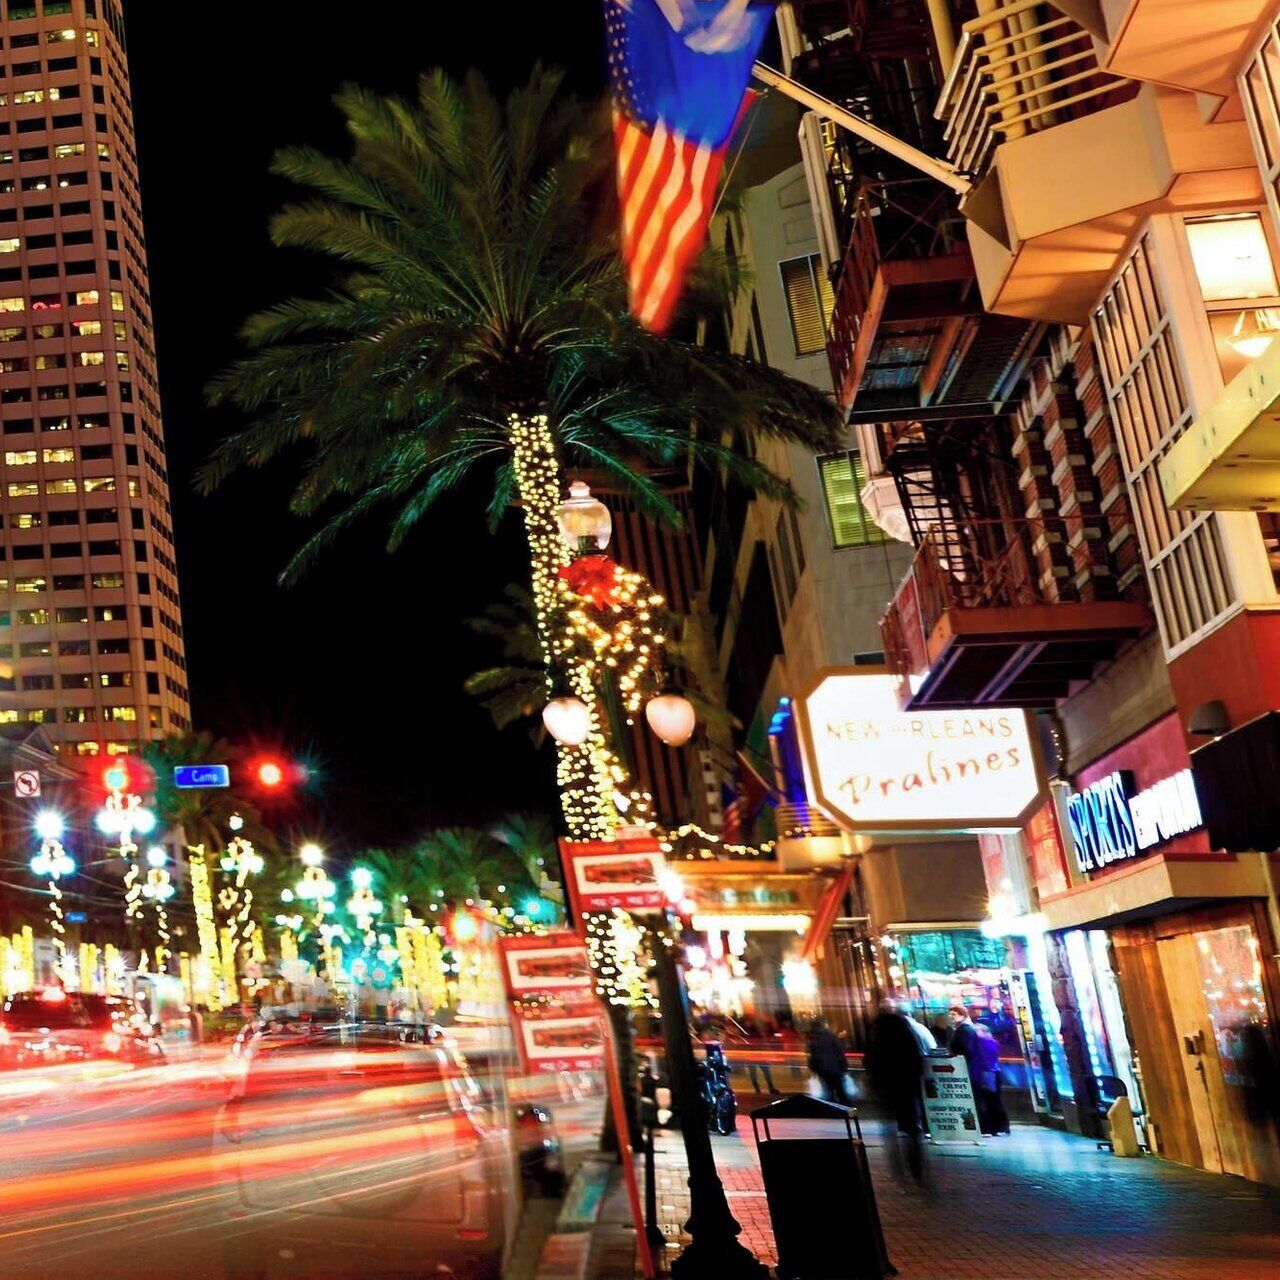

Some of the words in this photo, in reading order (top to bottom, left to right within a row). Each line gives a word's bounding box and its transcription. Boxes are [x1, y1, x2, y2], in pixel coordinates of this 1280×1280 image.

[891, 717, 1014, 741] RLEANS
[839, 747, 1021, 805] Pralines
[1067, 770, 1136, 872] SPORTS
